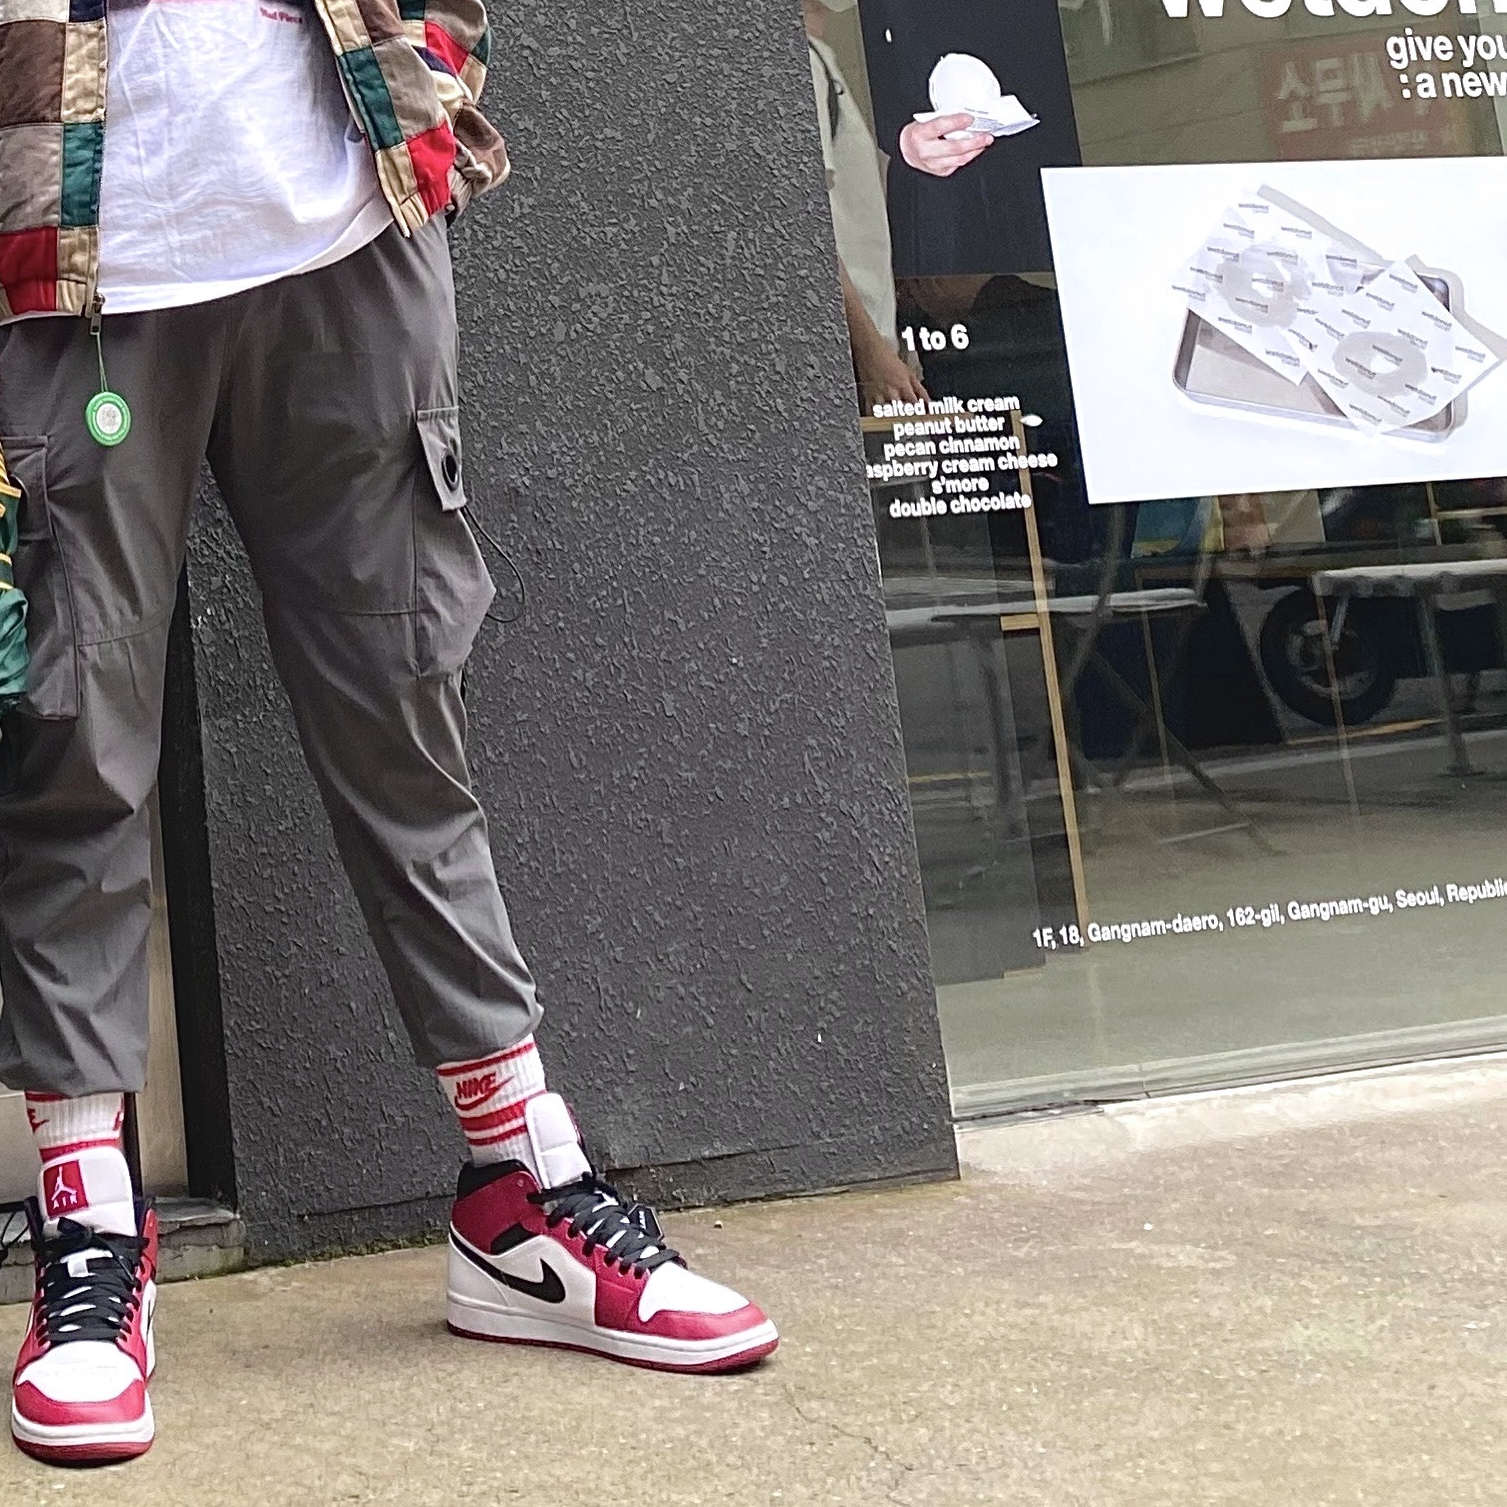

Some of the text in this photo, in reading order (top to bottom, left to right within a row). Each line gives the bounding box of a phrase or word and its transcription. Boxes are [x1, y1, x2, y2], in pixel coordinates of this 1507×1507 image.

[1386, 28, 1453, 70] give
[1415, 72, 1437, 99] a
[1441, 71, 1507, 99] new
[902, 324, 969, 351] 1 to 6
[873, 395, 1020, 418] salted milk cream
[893, 416, 1005, 441] peanut butter
[883, 434, 1020, 460] pecan cinnamon
[942, 456, 995, 473] cream
[997, 452, 1058, 471] cheese
[932, 477, 989, 494] s'more
[890, 492, 1031, 518] double chocolate
[1032, 926, 1057, 950] 1F,
[1059, 924, 1085, 947] 18,
[1087, 914, 1224, 943] Gangnam-daero,
[1226, 903, 1285, 928] 162-gil,
[1288, 895, 1394, 921] Gangnam-gu,
[1395, 886, 1445, 908] Seoul,
[456, 1072, 497, 1100] NIKE
